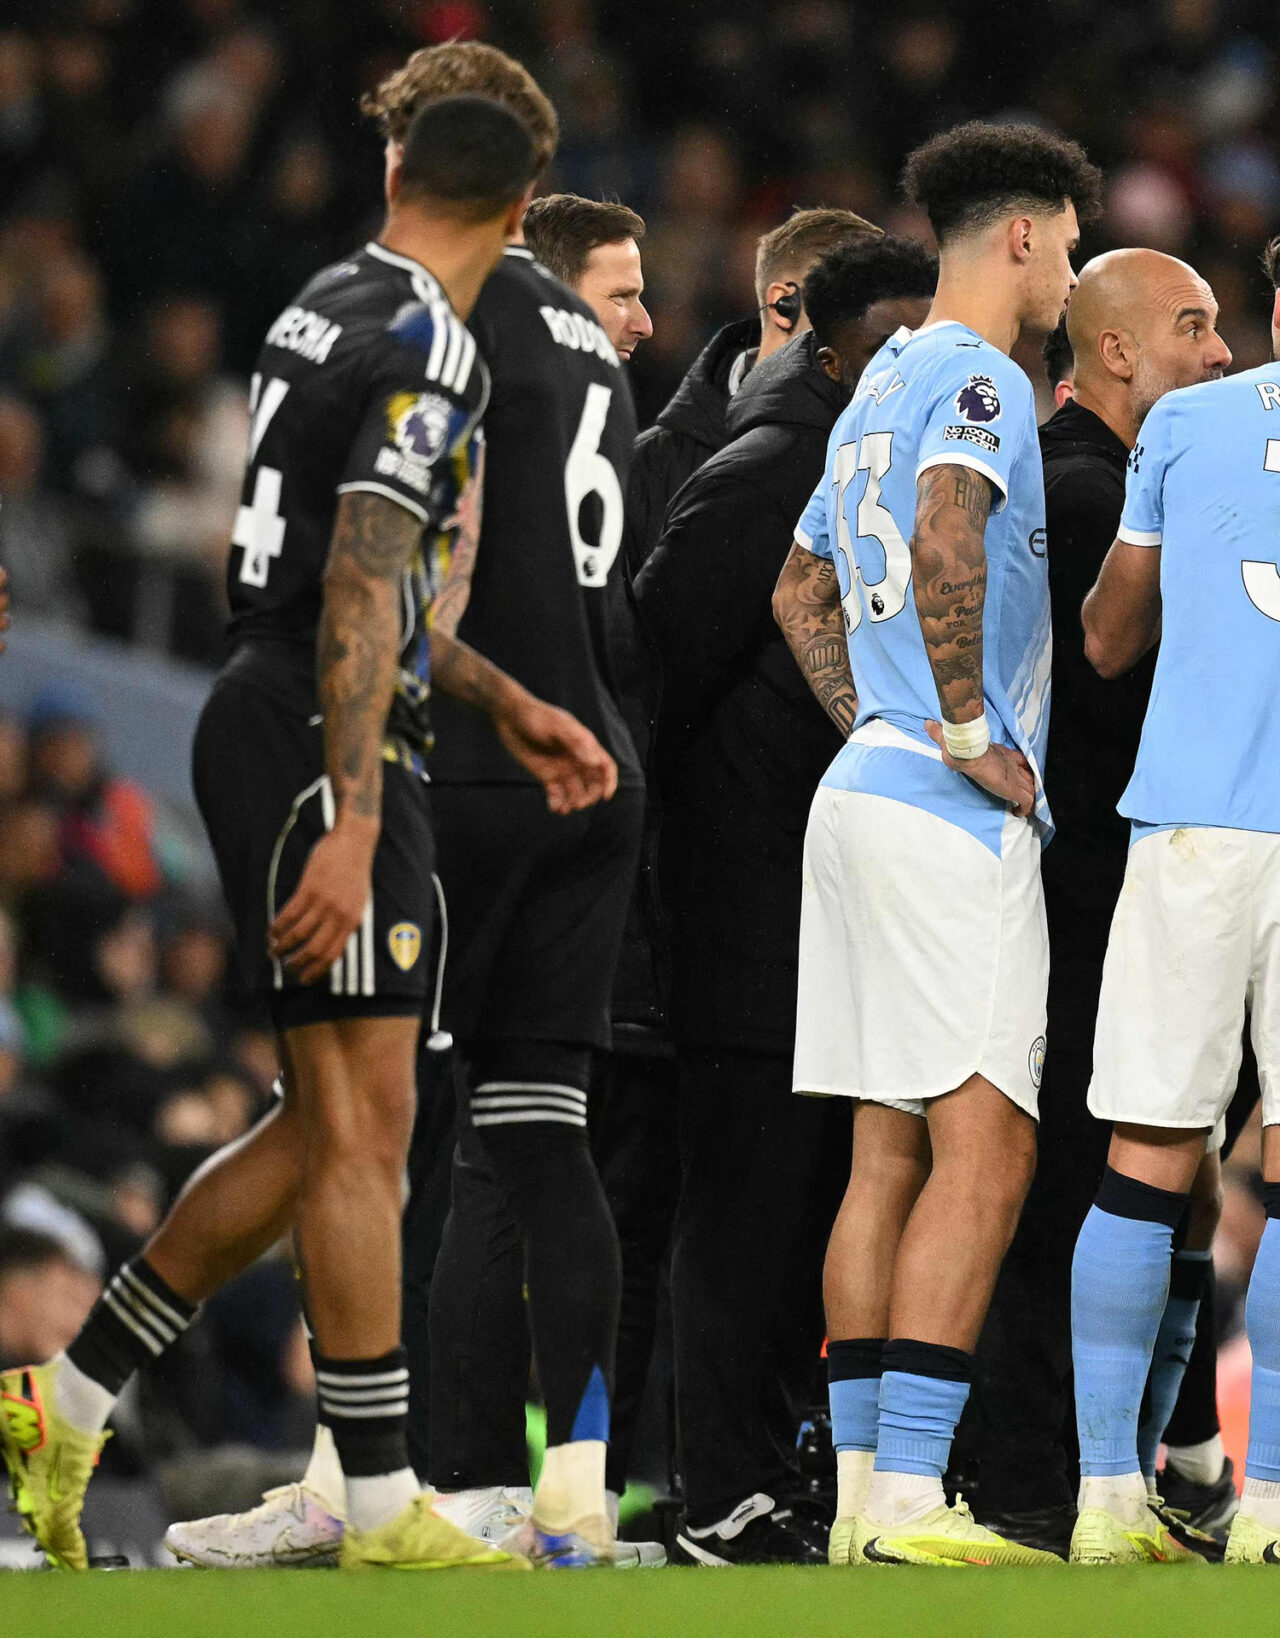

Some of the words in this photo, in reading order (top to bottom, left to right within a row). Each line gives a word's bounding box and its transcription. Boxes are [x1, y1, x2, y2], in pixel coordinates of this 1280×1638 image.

[565, 383, 625, 587] 6
[944, 426, 962, 434] No
[964, 427, 995, 445] room
